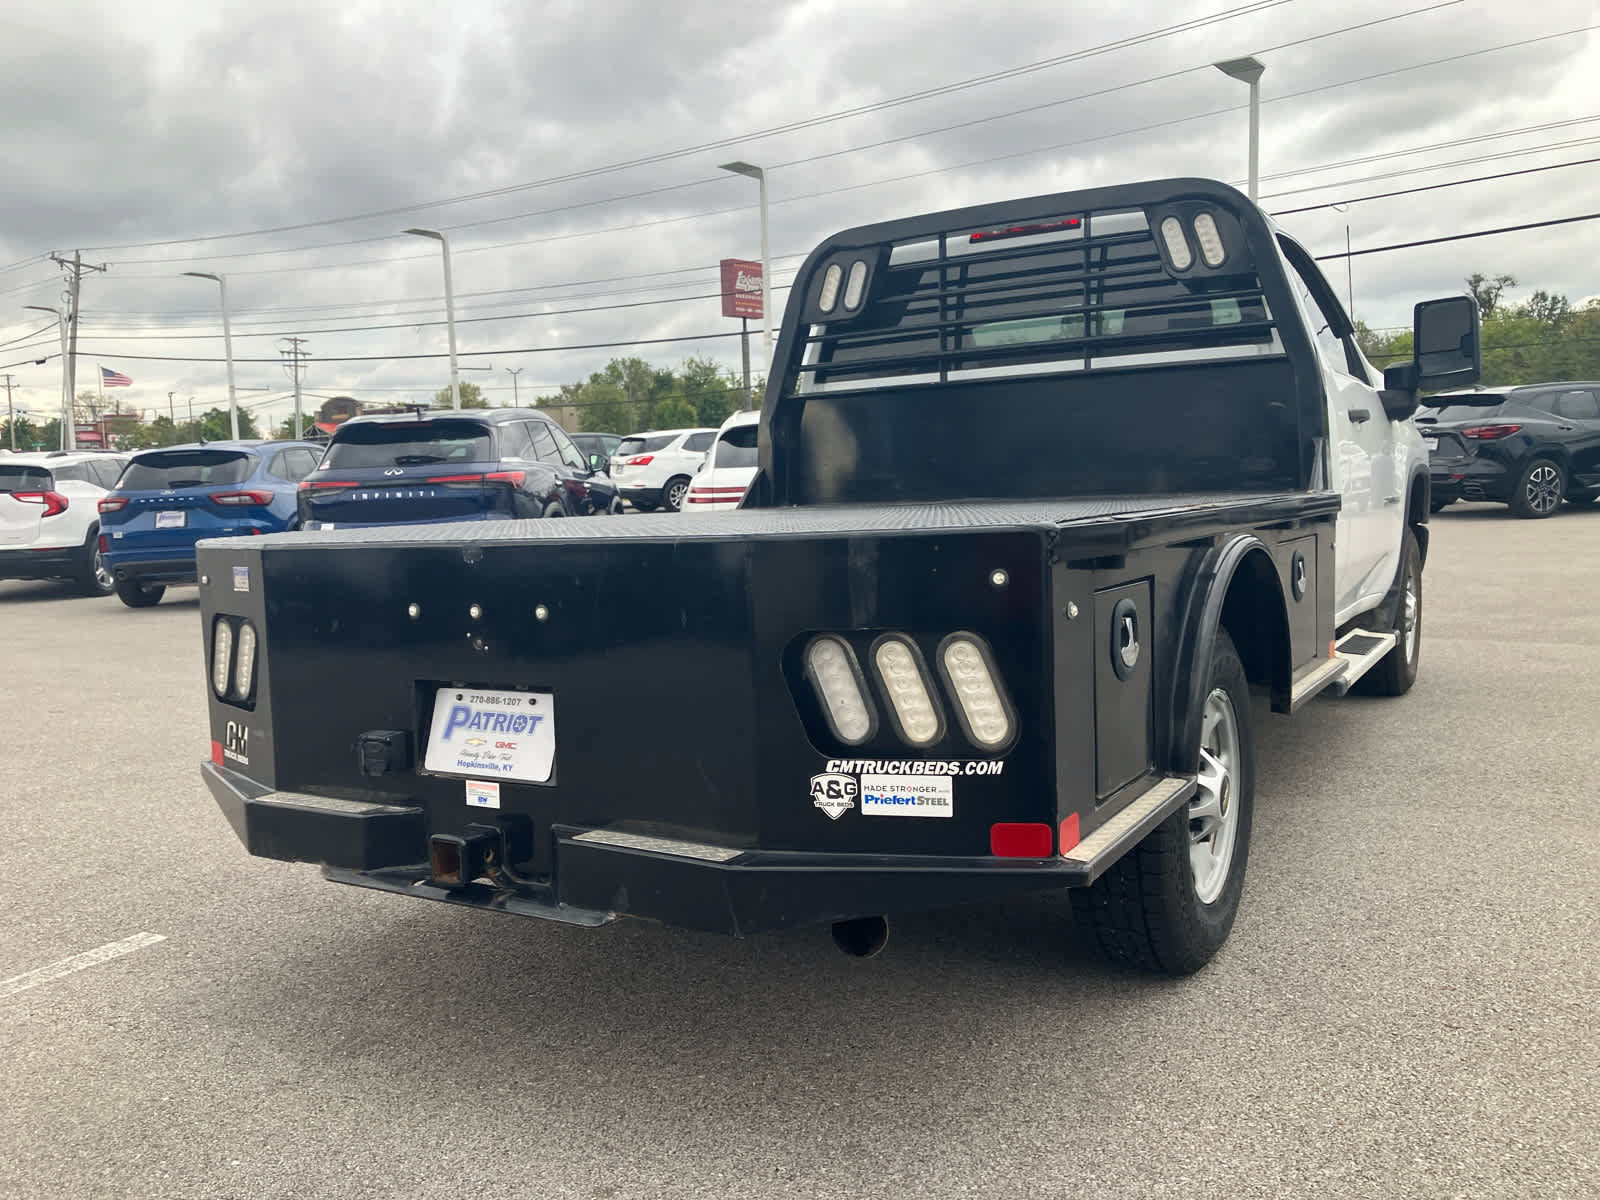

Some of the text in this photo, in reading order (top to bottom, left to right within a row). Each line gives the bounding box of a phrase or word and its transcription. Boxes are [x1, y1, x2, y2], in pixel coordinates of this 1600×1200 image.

[352, 491, 435, 500] INFINITI
[495, 741, 517, 749] GMC
[457, 760, 513, 772] Hopkinsville, KY
[826, 760, 1003, 775] CMTRUCKBEDS.COM
[811, 780, 857, 799] A&G
[890, 785, 937, 793] STRONGER
